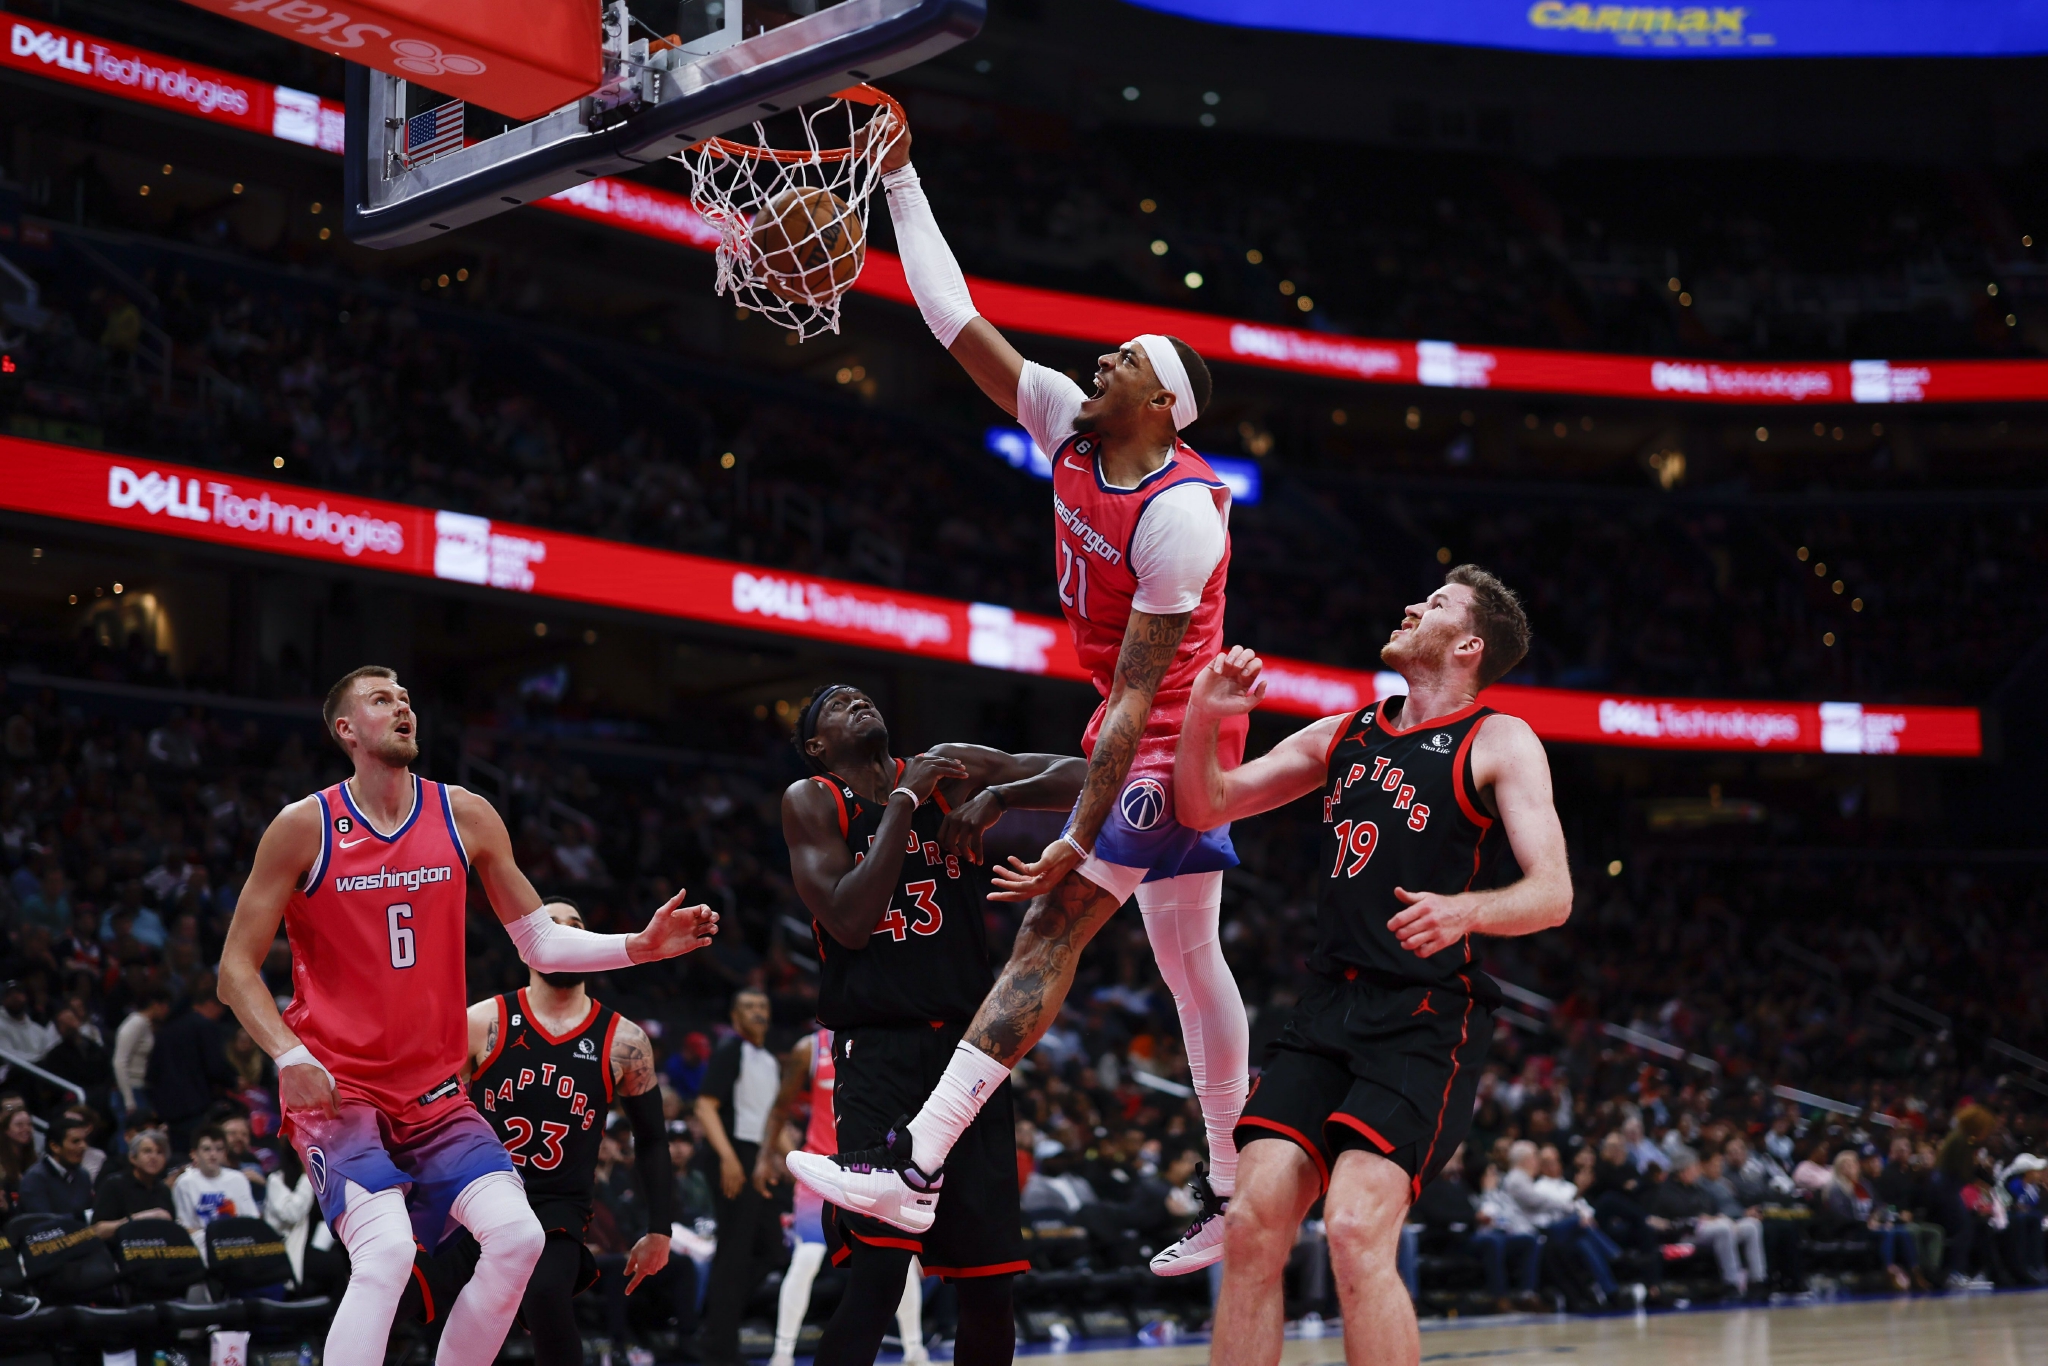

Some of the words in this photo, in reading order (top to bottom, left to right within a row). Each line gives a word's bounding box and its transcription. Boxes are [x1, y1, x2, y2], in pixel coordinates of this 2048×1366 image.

[11, 23, 92, 74] DELL
[90, 43, 248, 115] Technologies
[1076, 440, 1090, 454] 6
[107, 465, 210, 523] DELL
[206, 481, 404, 556] Technologies
[732, 572, 810, 622] DELL
[1058, 537, 1090, 620] 21
[1361, 712, 1374, 724] 6
[1420, 743, 1436, 752] Sun
[1323, 756, 1430, 832] RAPTORS
[338, 819, 349, 832] 6
[1331, 819, 1379, 878] 19
[335, 864, 452, 892] washington
[387, 902, 416, 970] 6
[871, 879, 943, 942] 43
[511, 1014, 522, 1026] 6
[484, 1063, 596, 1130] RAPTORS
[503, 1116, 569, 1171] 23
